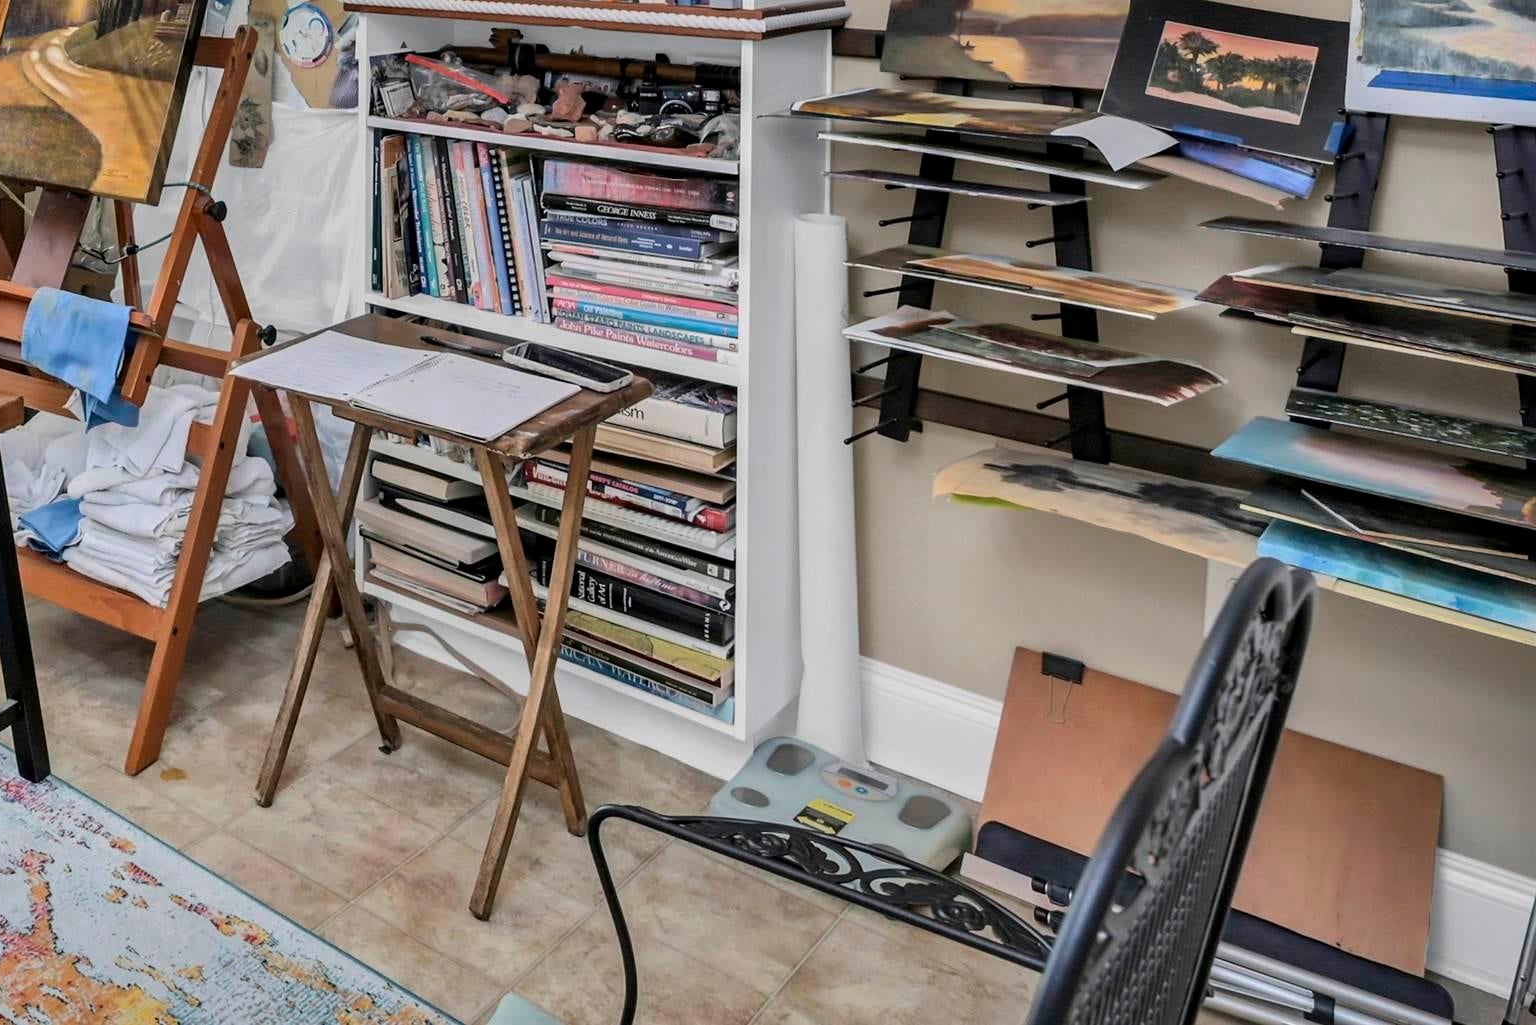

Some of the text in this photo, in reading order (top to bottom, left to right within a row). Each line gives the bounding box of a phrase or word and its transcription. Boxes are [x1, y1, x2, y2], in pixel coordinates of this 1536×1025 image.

[575, 215, 609, 227] COLORS
[596, 204, 629, 216] GEORGE
[629, 208, 657, 220] INNESS
[559, 319, 695, 356] John Pike Paints Watercolors
[645, 325, 706, 344] LANDSCAPES
[618, 407, 644, 420] ism
[576, 549, 627, 575] TURNER
[576, 570, 586, 597] National
[585, 575, 598, 602] Gallery
[597, 582, 606, 604] of Art
